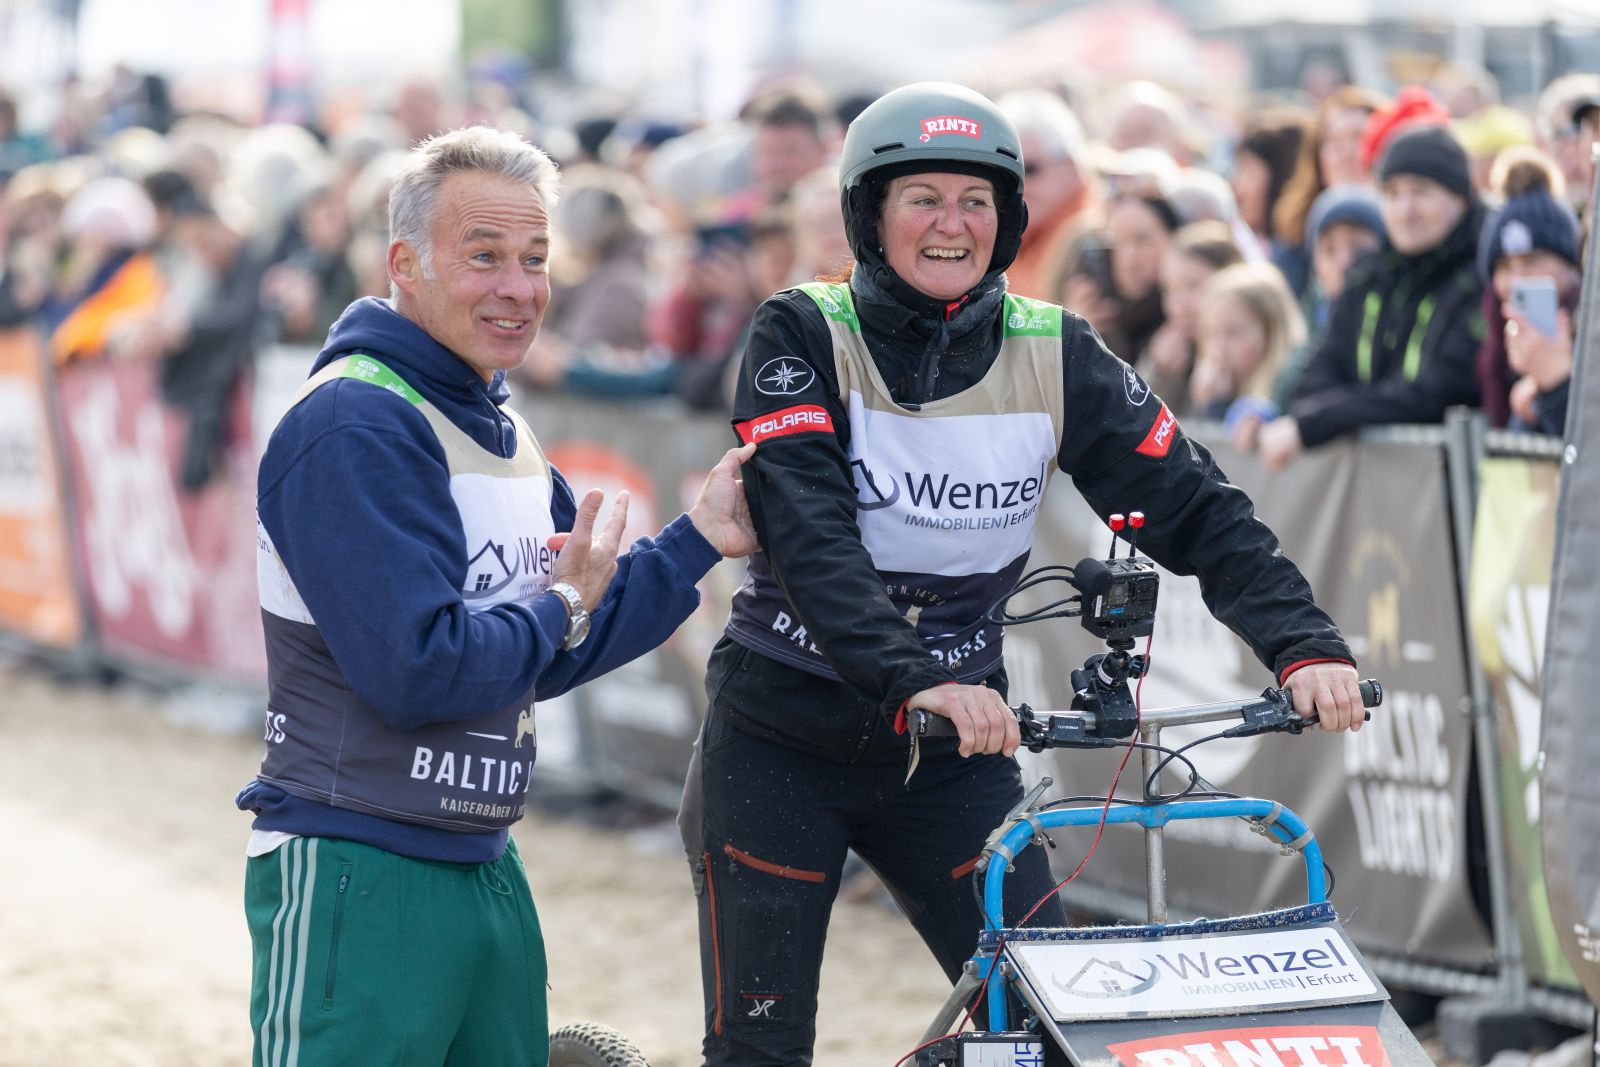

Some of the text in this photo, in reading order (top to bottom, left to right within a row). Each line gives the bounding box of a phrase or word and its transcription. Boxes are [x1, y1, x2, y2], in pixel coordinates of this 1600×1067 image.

[925, 118, 978, 135] RINTI
[752, 411, 826, 440] POLARIS
[904, 462, 1045, 509] Wenzel
[904, 514, 1002, 531] IMMOBILIEN
[1010, 503, 1038, 526] Erfurt
[410, 746, 522, 795] BALTIC
[440, 797, 511, 818] KAISERBÄDER
[1156, 938, 1348, 980] Wenzel
[1181, 976, 1297, 996] IMMOBILIEN
[1308, 971, 1358, 987] Erfurt
